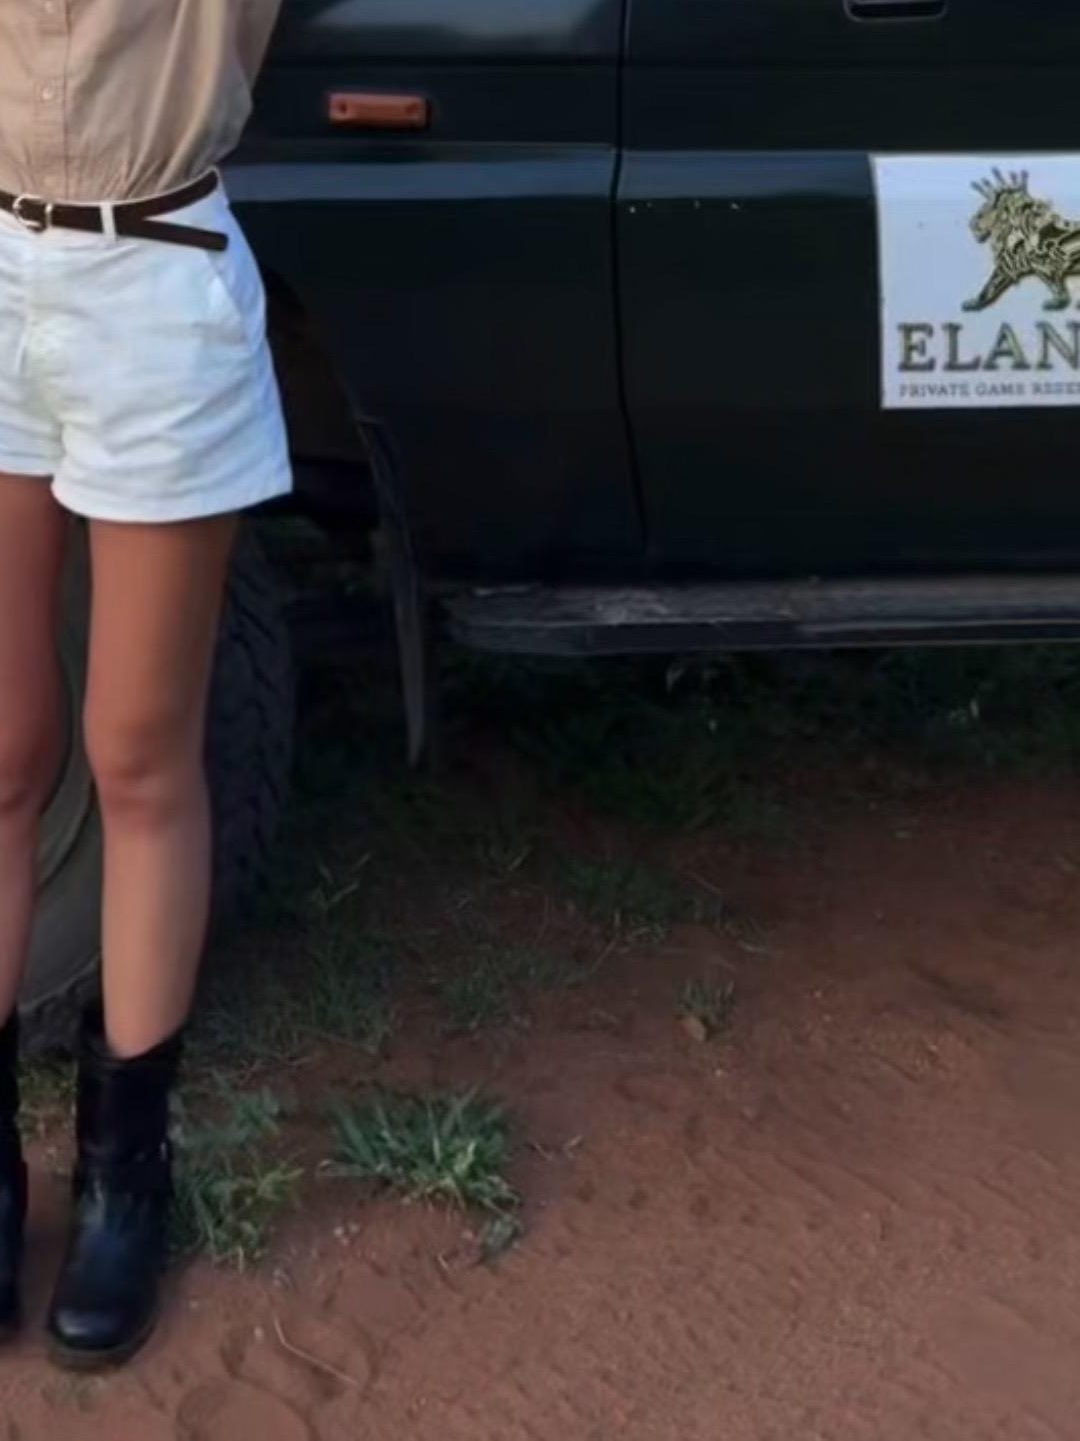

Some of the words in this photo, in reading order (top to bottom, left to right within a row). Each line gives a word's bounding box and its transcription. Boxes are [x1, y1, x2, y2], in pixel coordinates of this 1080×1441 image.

[898, 322, 1080, 372] ELAN
[899, 383, 968, 397] PRIVATE
[975, 382, 1025, 395] GAME
[1032, 381, 1080, 394] RESE
